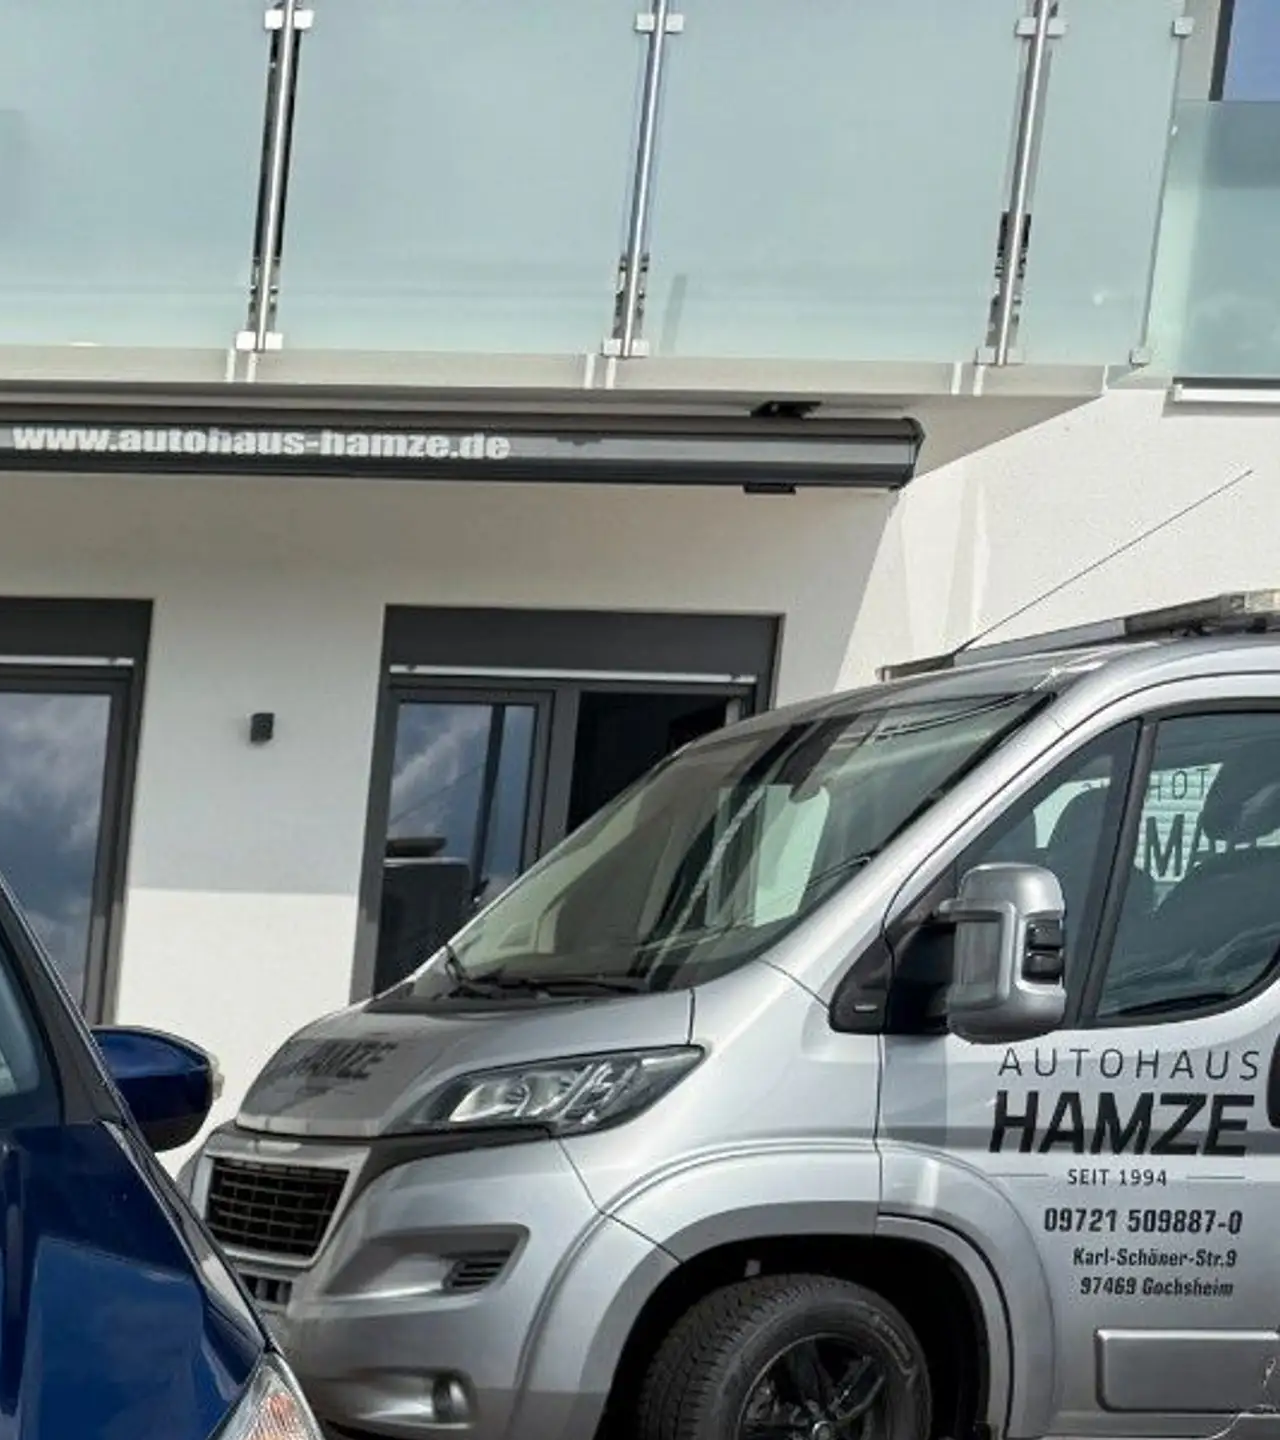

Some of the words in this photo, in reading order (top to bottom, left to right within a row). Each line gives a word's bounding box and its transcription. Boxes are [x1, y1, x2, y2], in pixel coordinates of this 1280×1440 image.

[12, 426, 511, 460] www.autohaus-hamze.de
[997, 1047, 1261, 1081] AUTOHAUS
[988, 1089, 1255, 1157] HAMZE
[1066, 1168, 1110, 1186] SEIT
[1118, 1168, 1168, 1187] 1994
[1043, 1207, 1119, 1233] 09721
[1126, 1208, 1244, 1235] 509887-0
[1079, 1276, 1138, 1296] 97469
[1142, 1276, 1235, 1298] Gochsheim
